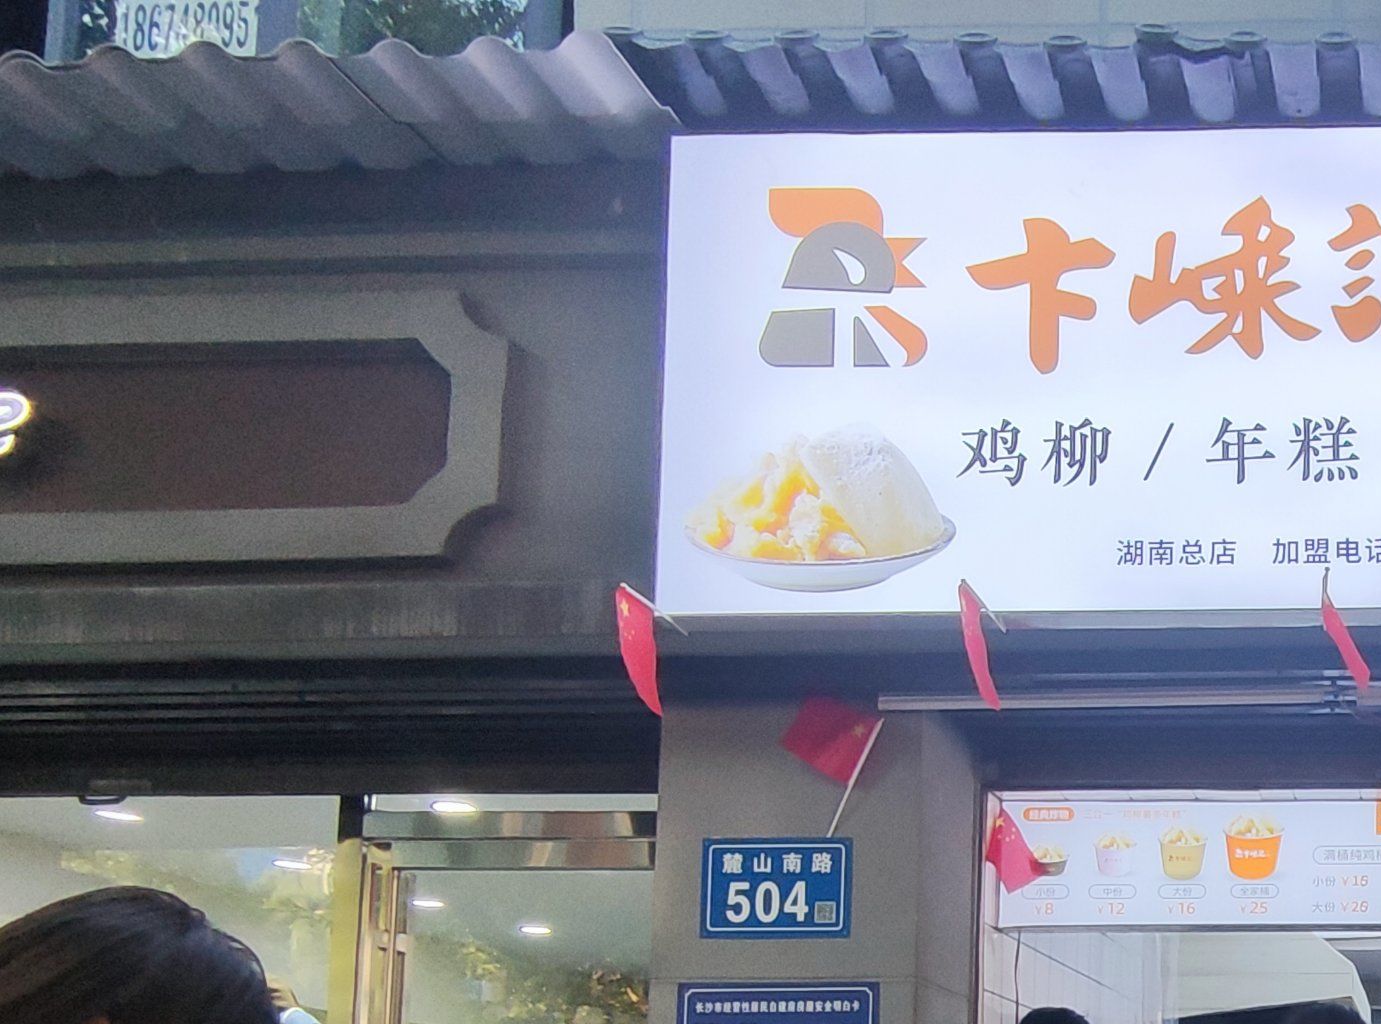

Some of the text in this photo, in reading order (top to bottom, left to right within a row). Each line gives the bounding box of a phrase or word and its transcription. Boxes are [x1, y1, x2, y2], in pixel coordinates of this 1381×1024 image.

[1116, 538, 1237, 566] 湖南总店
[722, 852, 833, 874] 麓山南路
[725, 881, 809, 923] 504
